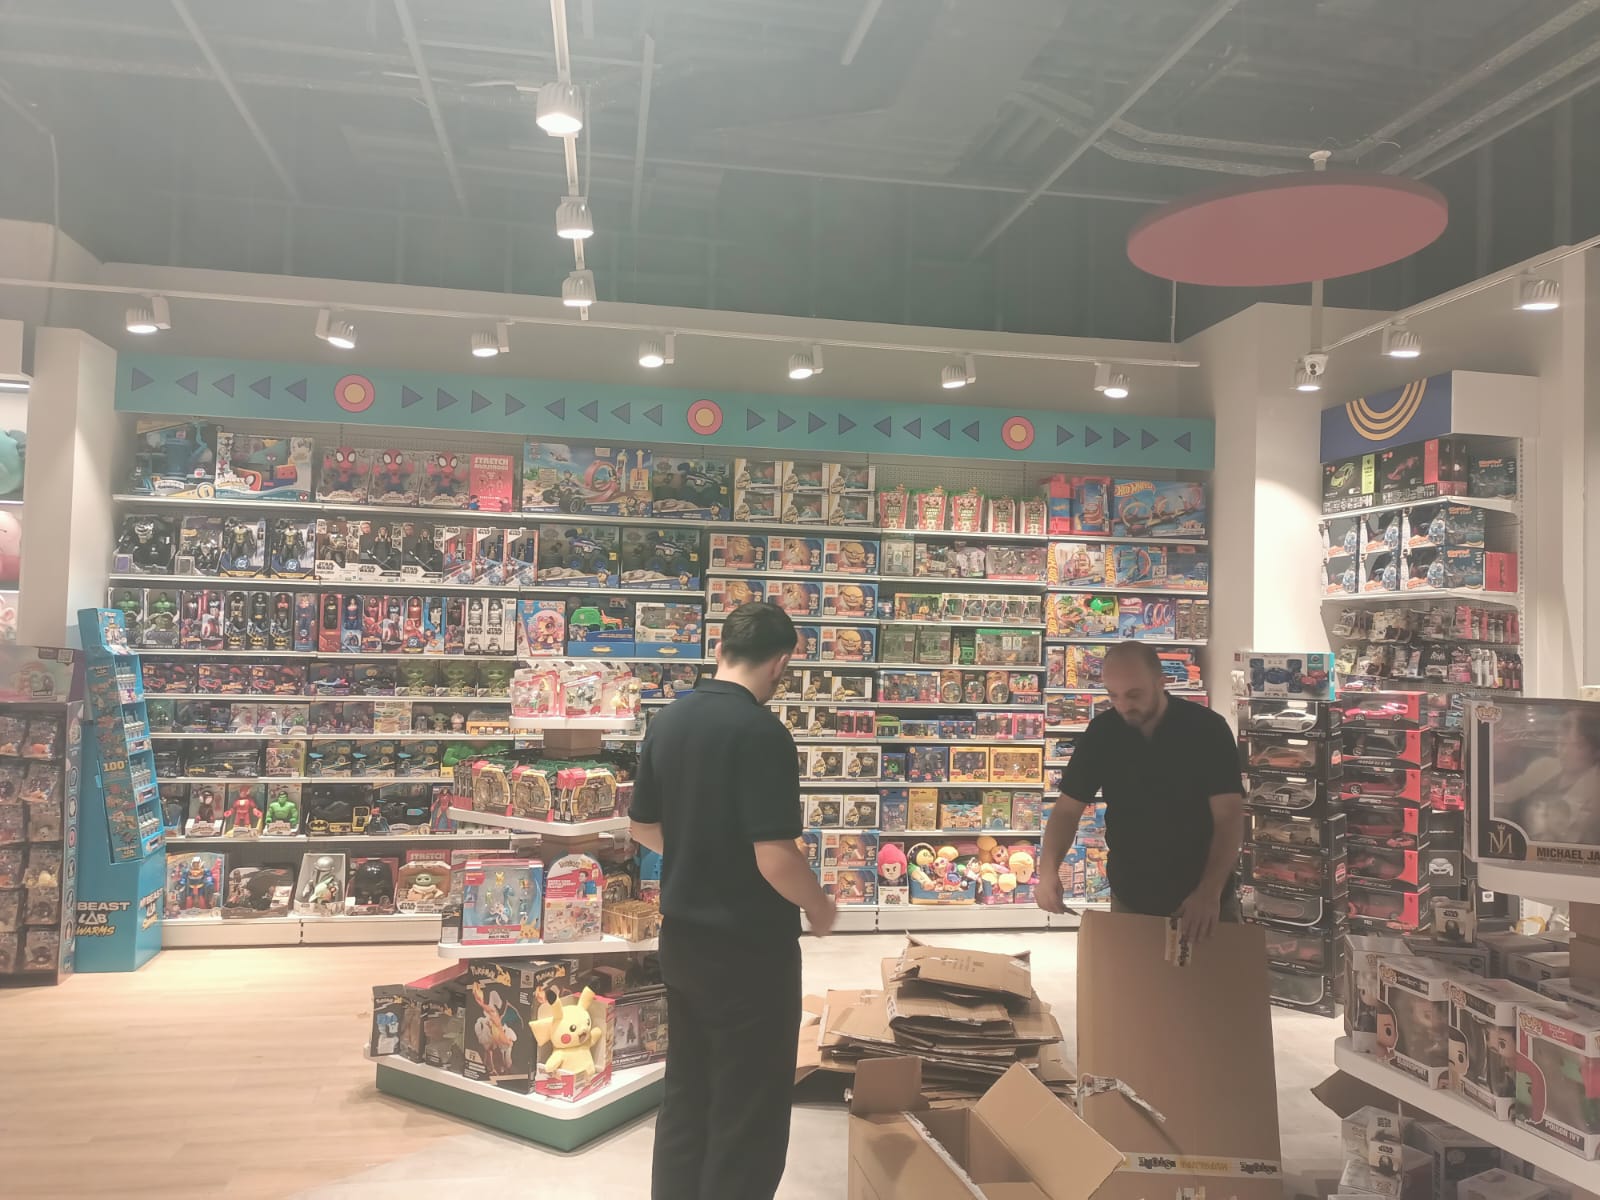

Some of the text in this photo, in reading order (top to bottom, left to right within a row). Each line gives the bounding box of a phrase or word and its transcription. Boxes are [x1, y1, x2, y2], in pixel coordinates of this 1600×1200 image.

[1536, 846, 1585, 862] MICHAEL
[77, 901, 131, 911] BEAST
[1545, 1119, 1581, 1144] POISON IVY
